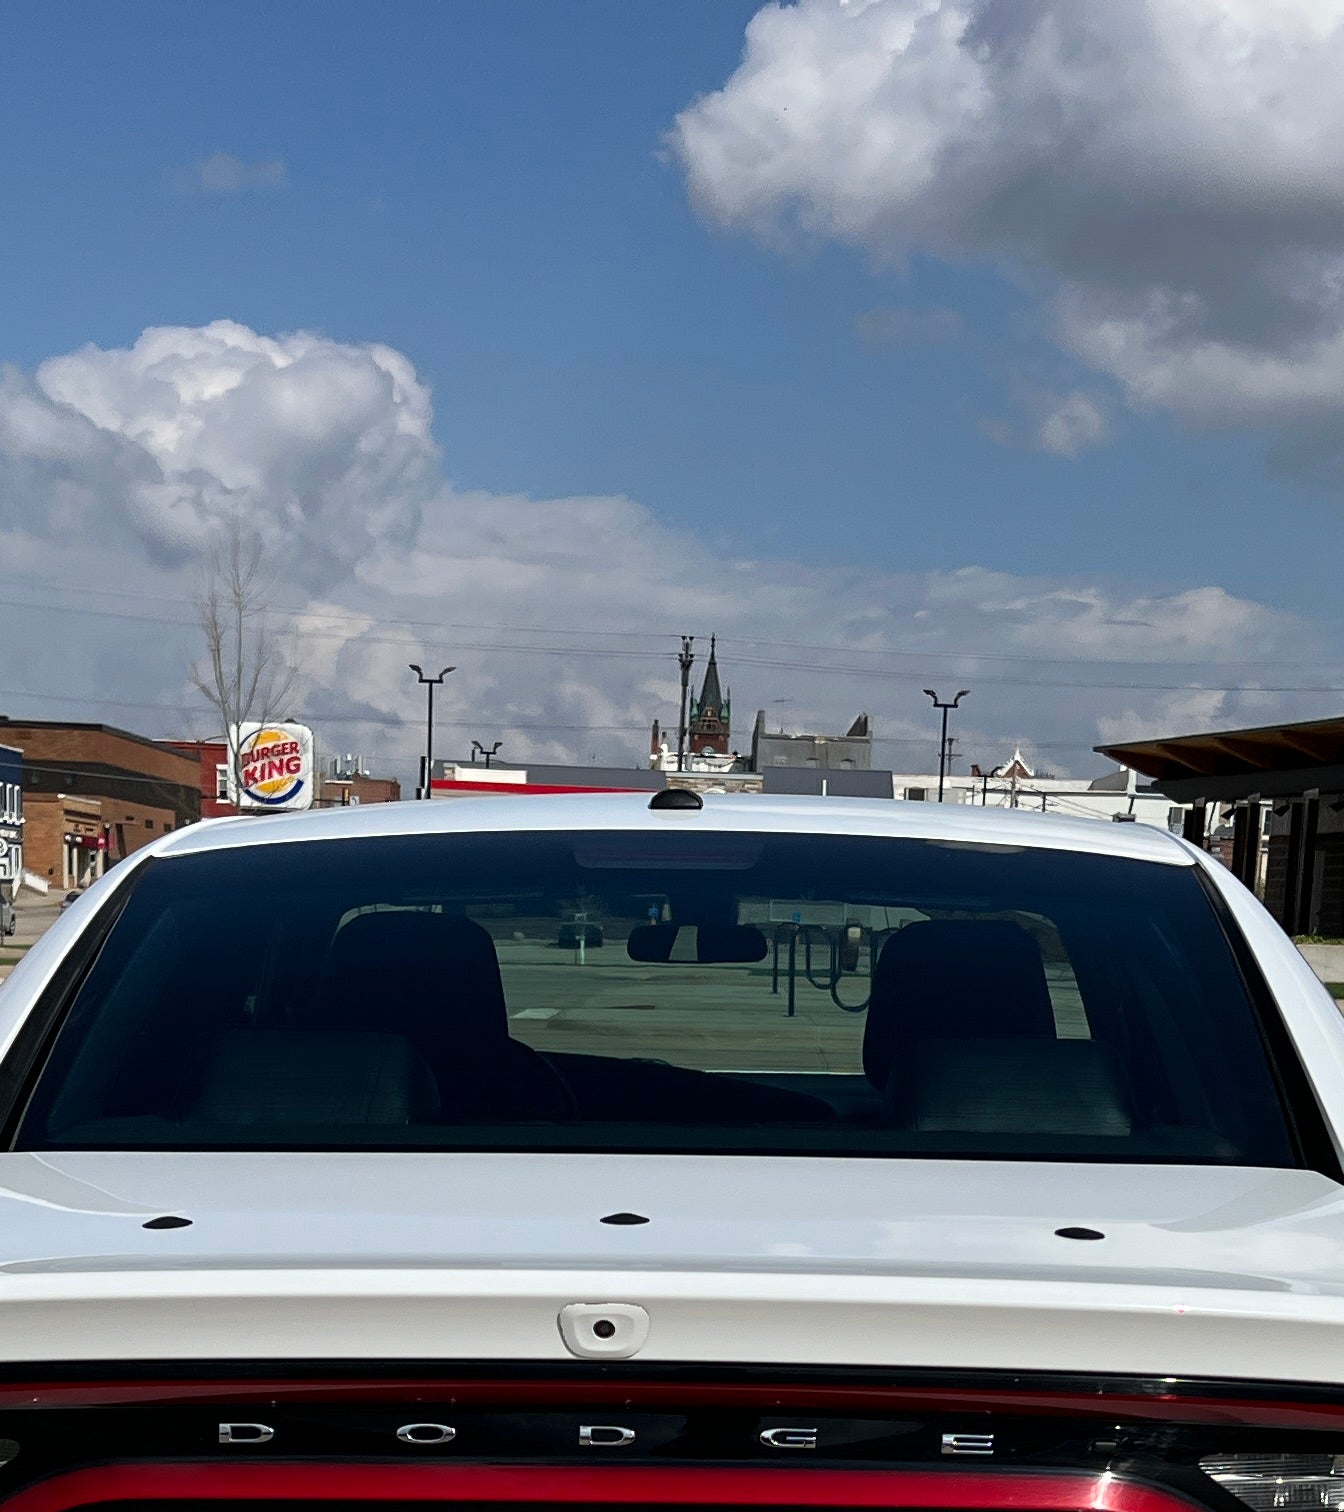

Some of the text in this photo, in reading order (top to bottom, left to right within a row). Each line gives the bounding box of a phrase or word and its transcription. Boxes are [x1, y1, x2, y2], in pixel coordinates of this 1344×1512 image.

[242, 742, 299, 767] BURGER
[243, 756, 301, 788] KING
[219, 1421, 995, 1455] DODGE
